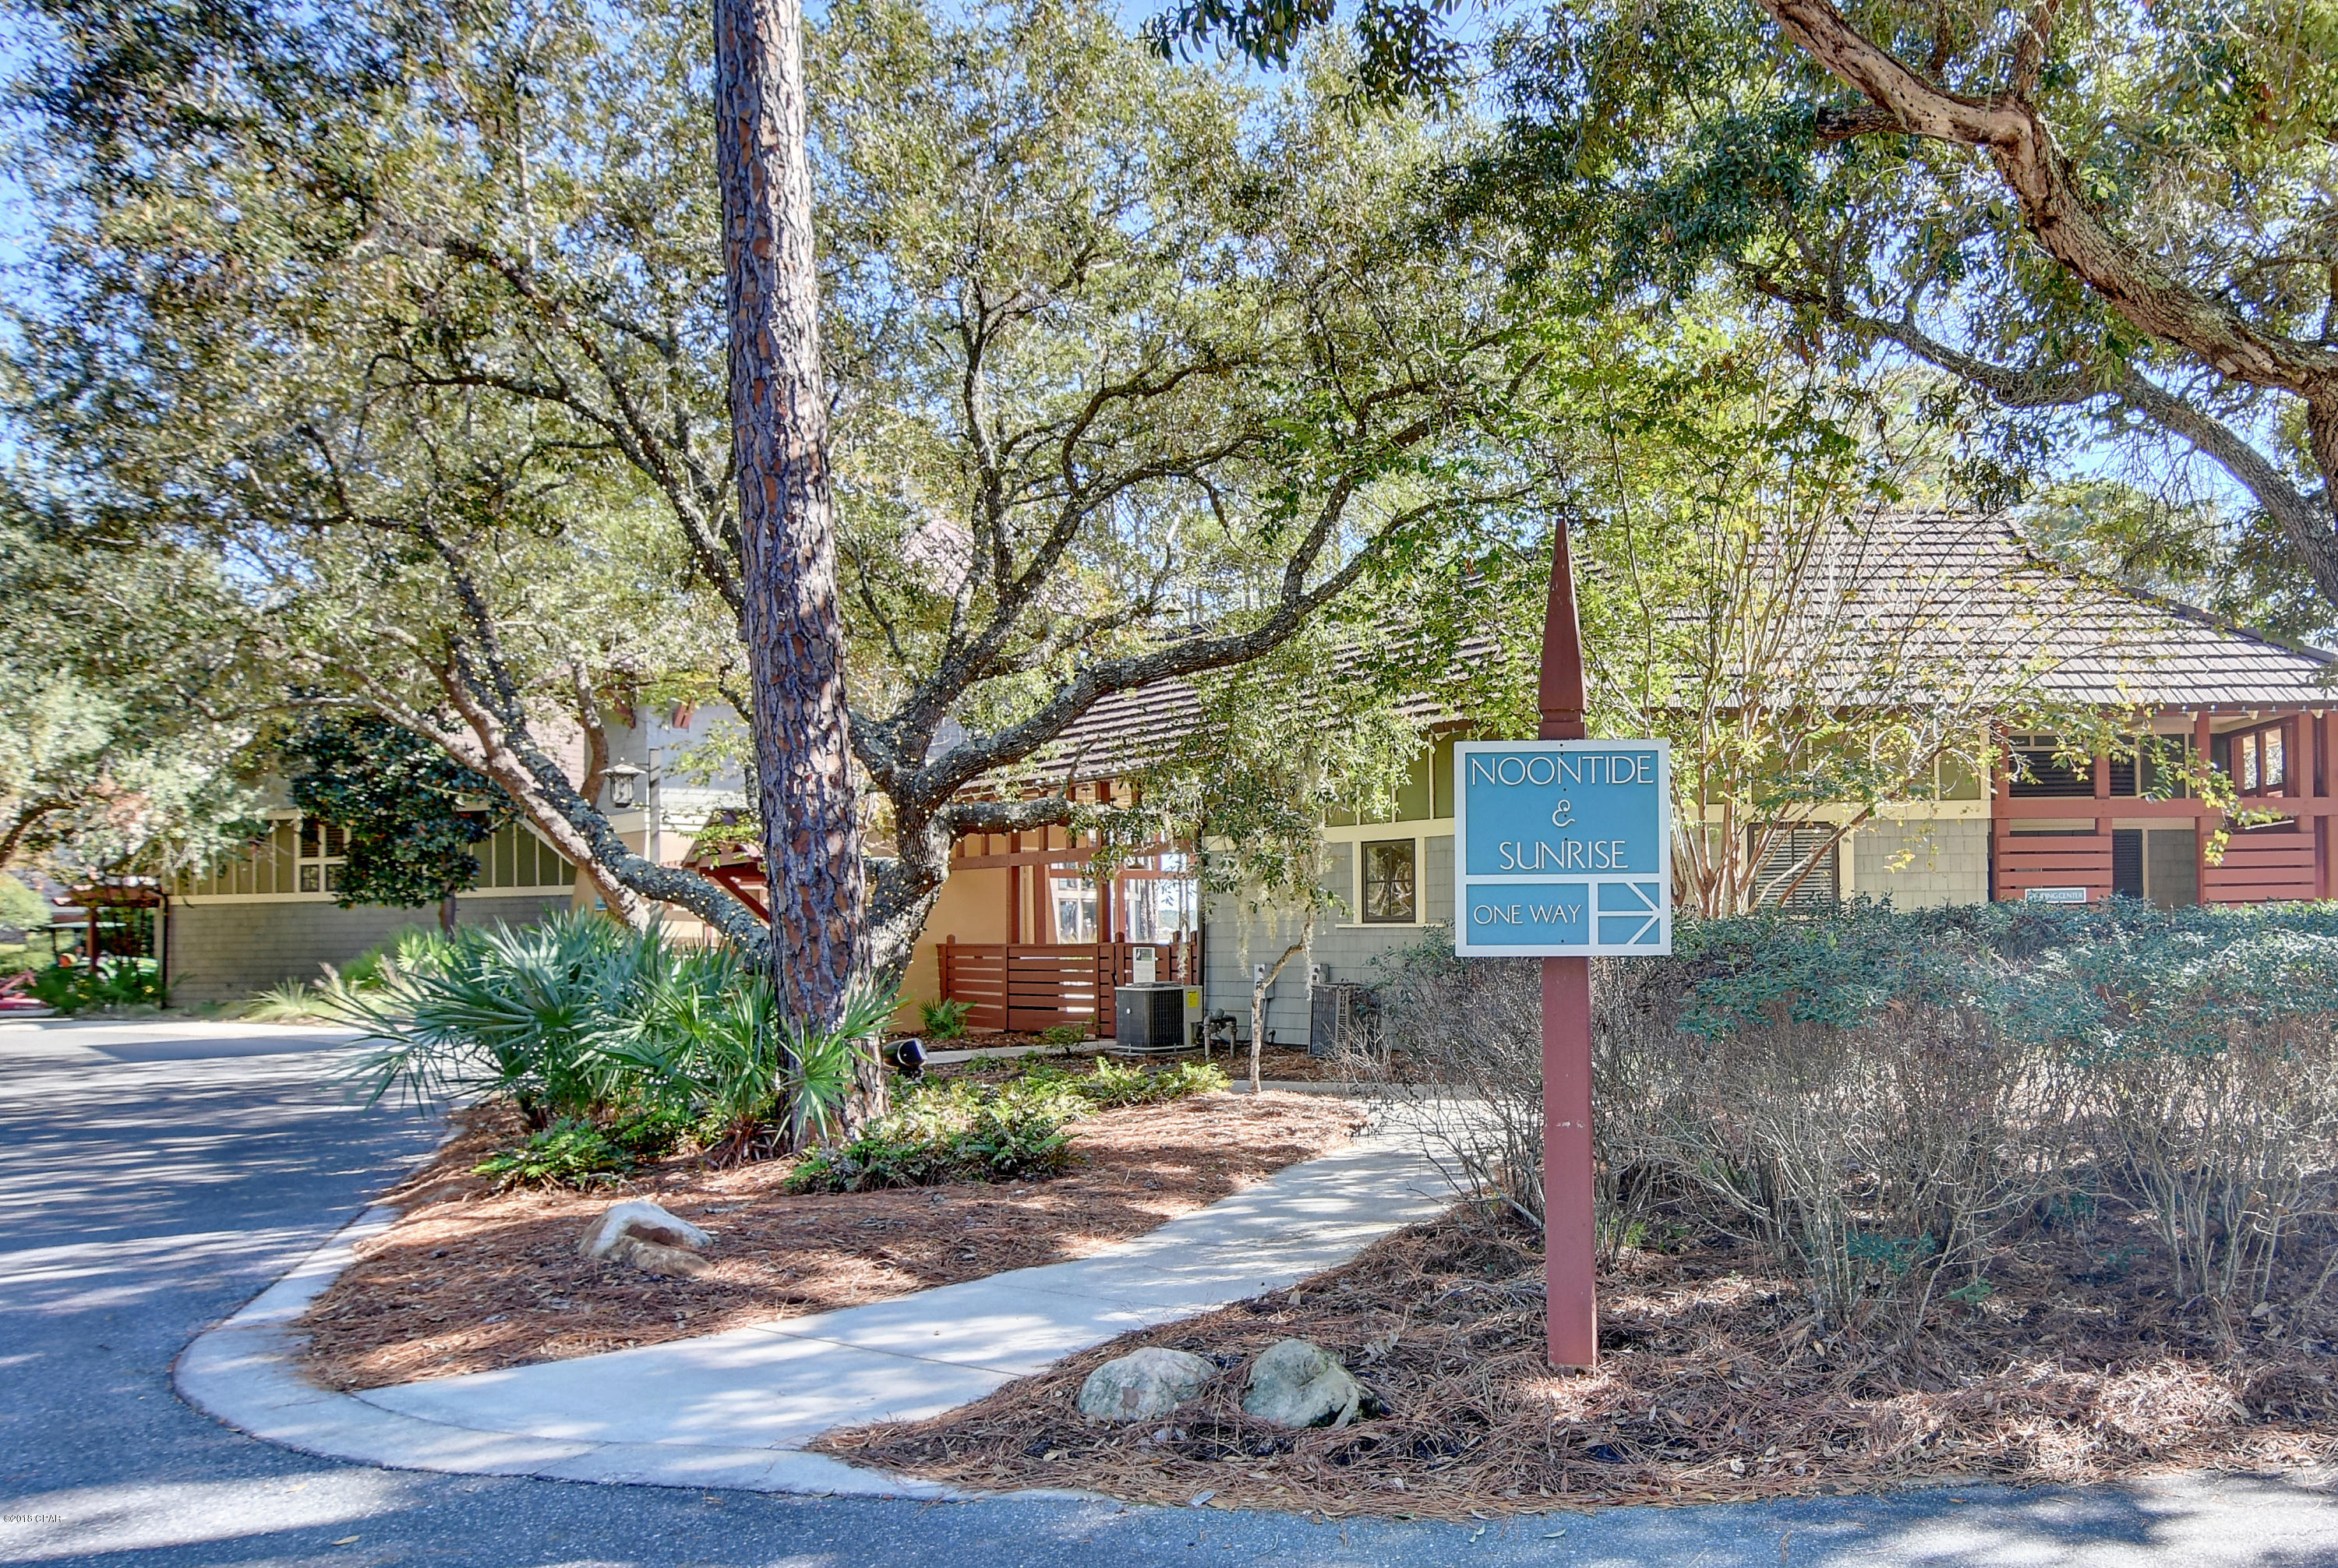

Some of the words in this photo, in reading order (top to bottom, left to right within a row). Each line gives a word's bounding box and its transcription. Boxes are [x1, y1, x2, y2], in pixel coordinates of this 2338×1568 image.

[1471, 755, 1654, 786] NOONTIDE
[1552, 799, 1576, 828] &
[1499, 840, 1629, 870] SUNRISE
[1473, 904, 1523, 925] ONE
[1529, 904, 1582, 924] WAY
